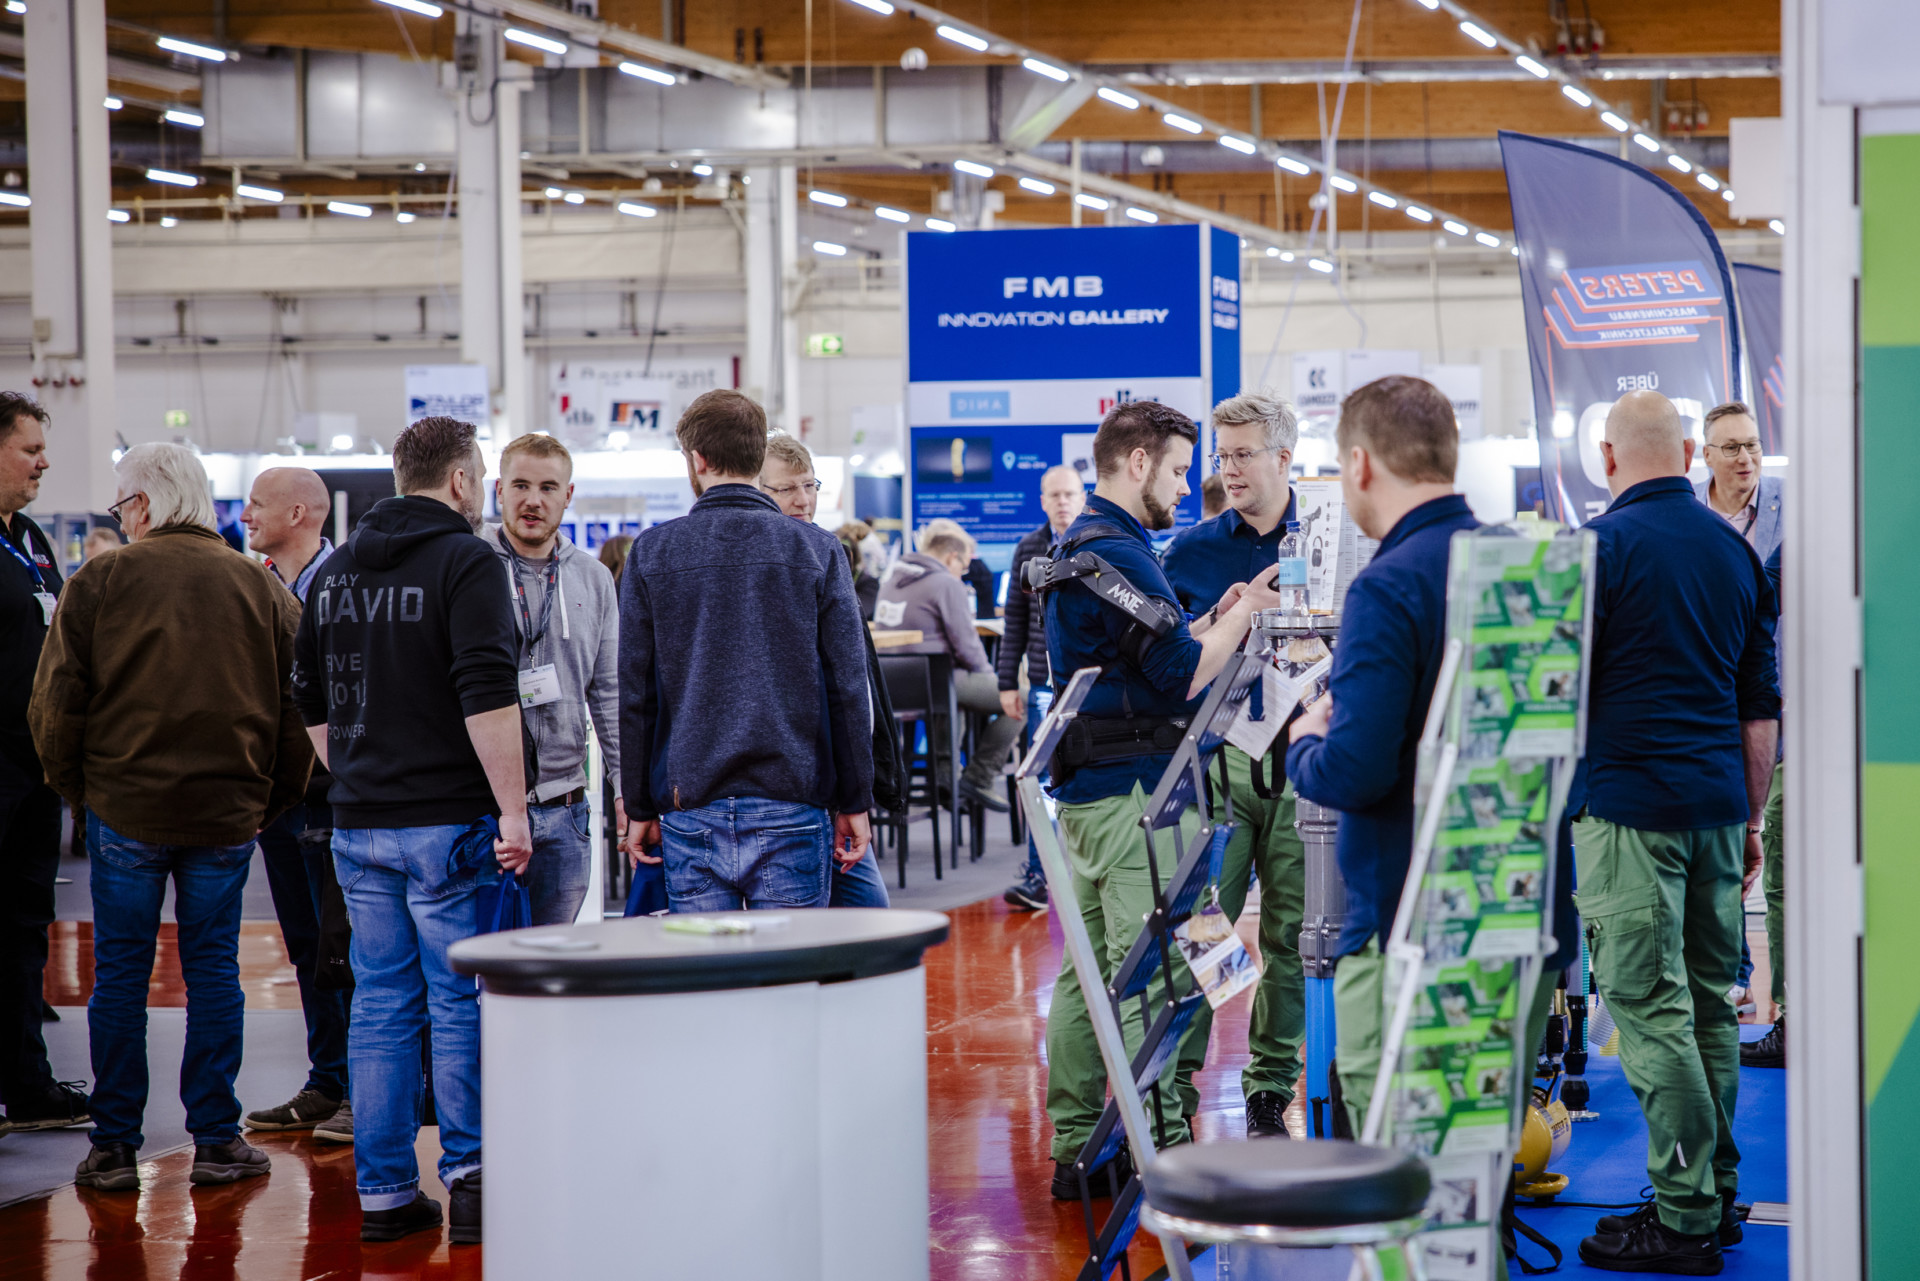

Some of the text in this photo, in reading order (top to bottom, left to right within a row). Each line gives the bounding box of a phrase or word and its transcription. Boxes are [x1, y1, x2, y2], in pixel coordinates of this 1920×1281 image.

[1003, 276, 1103, 298] FMB
[938, 308, 1169, 328] INNOVATION GALLERY
[324, 573, 360, 589] PLAY
[318, 586, 424, 626] DAVID
[1106, 583, 1144, 615] MATE
[327, 724, 367, 740] POWER
